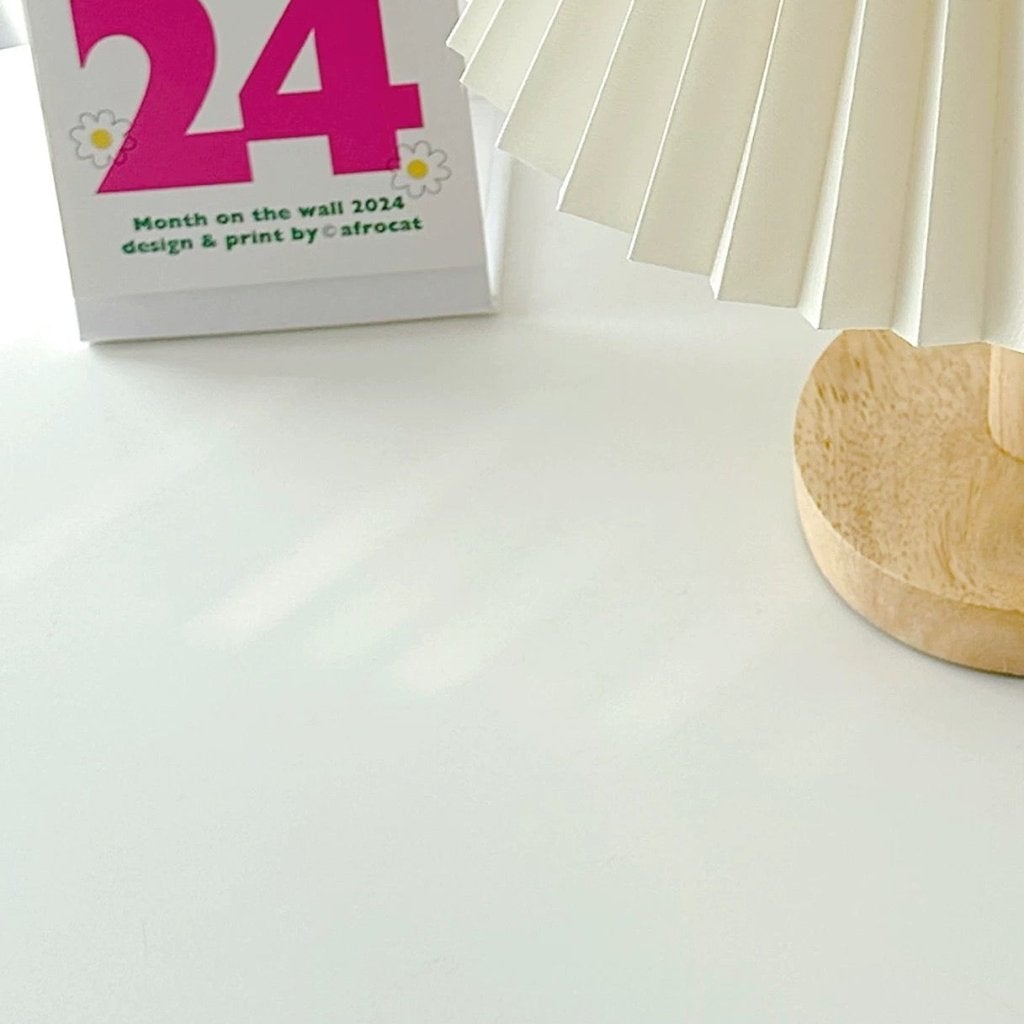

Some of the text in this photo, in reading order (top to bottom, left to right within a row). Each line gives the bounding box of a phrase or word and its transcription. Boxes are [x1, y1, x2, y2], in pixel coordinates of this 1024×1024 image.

[132, 195, 405, 231] Month on the wall 2024
[121, 238, 194, 256] design
[201, 234, 217, 249] &
[225, 228, 285, 251] print
